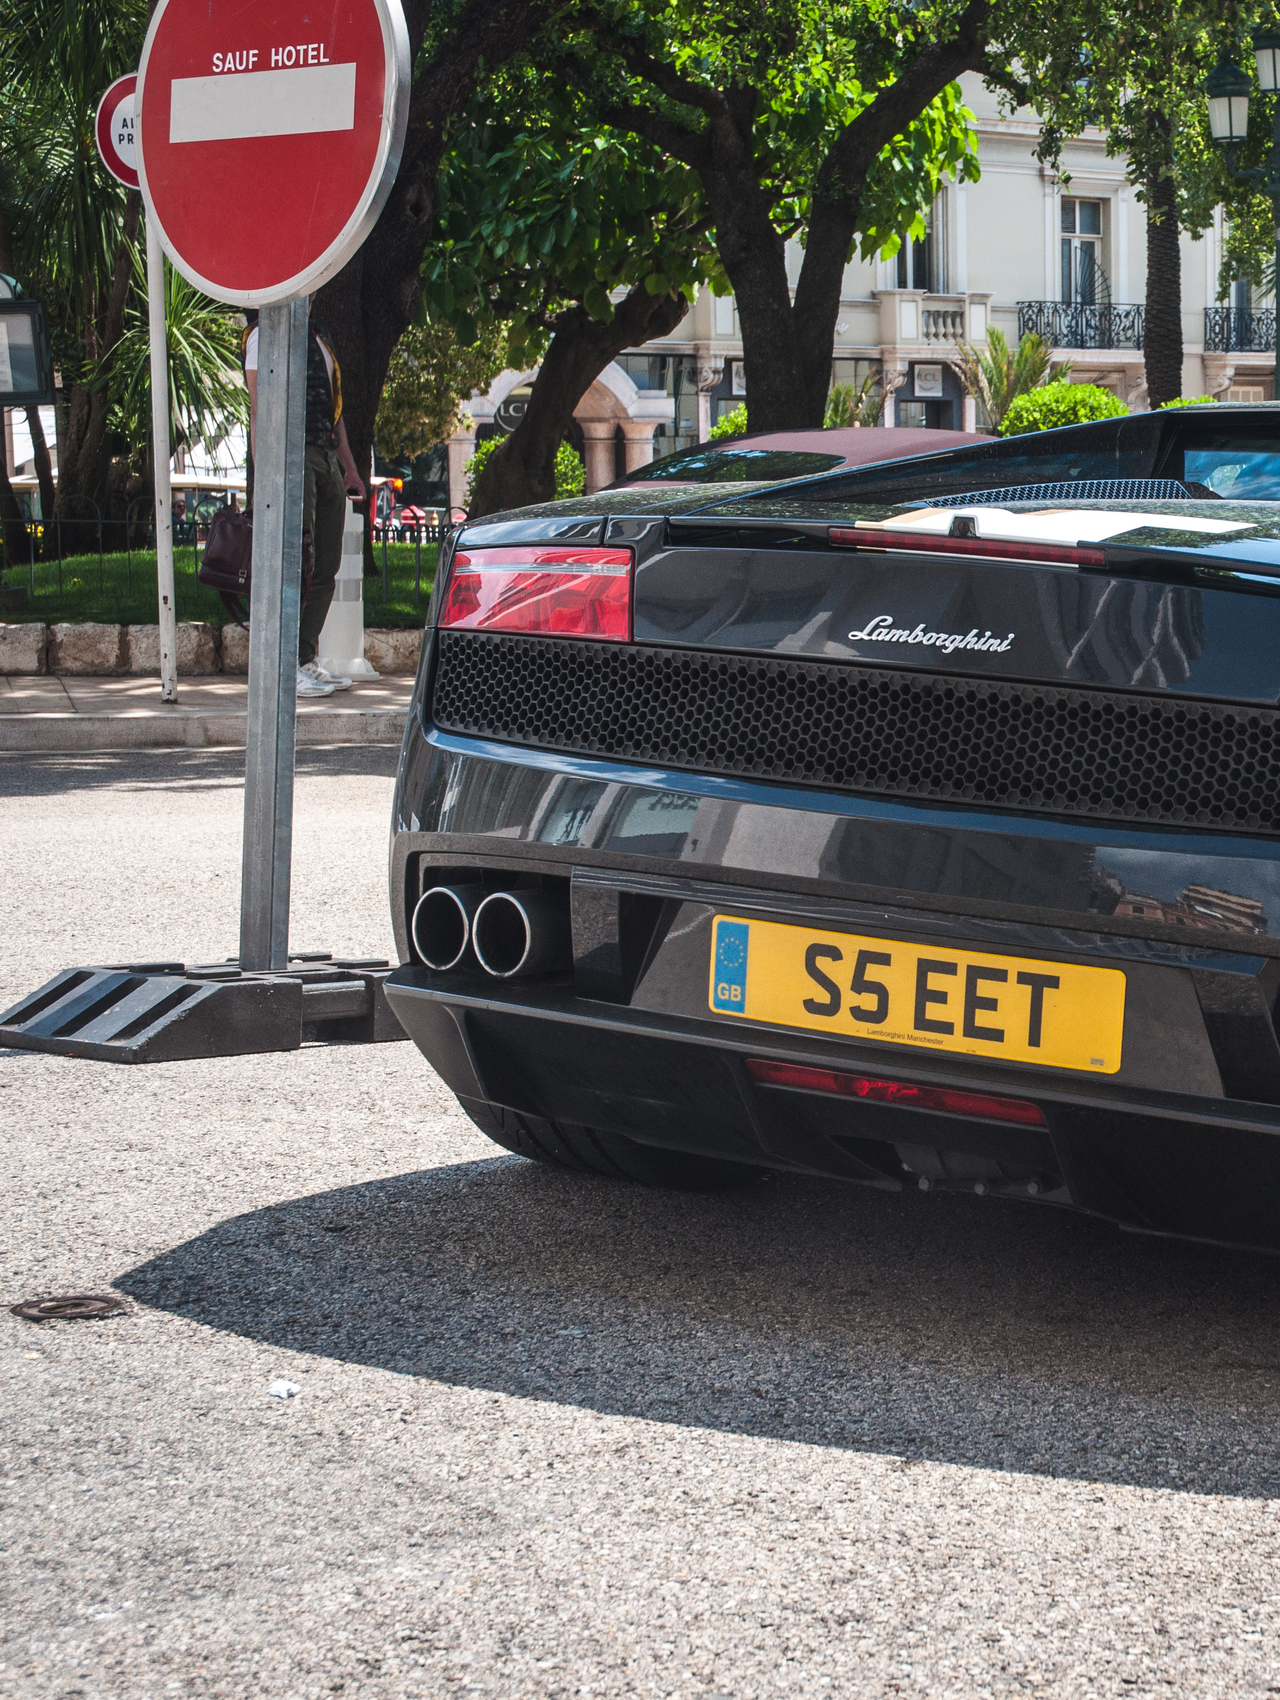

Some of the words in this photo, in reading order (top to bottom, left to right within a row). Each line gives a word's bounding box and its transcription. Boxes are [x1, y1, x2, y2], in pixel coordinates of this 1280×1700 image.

[212, 49, 259, 73] SAUF
[270, 43, 330, 67] HOTEL
[848, 615, 1016, 654] Lamborghini
[717, 982, 742, 1002] GB
[802, 942, 892, 1024] S5
[913, 957, 1061, 1049] EET
[867, 1028, 905, 1041] Lamborghini
[907, 1034, 944, 1046] Manchester
